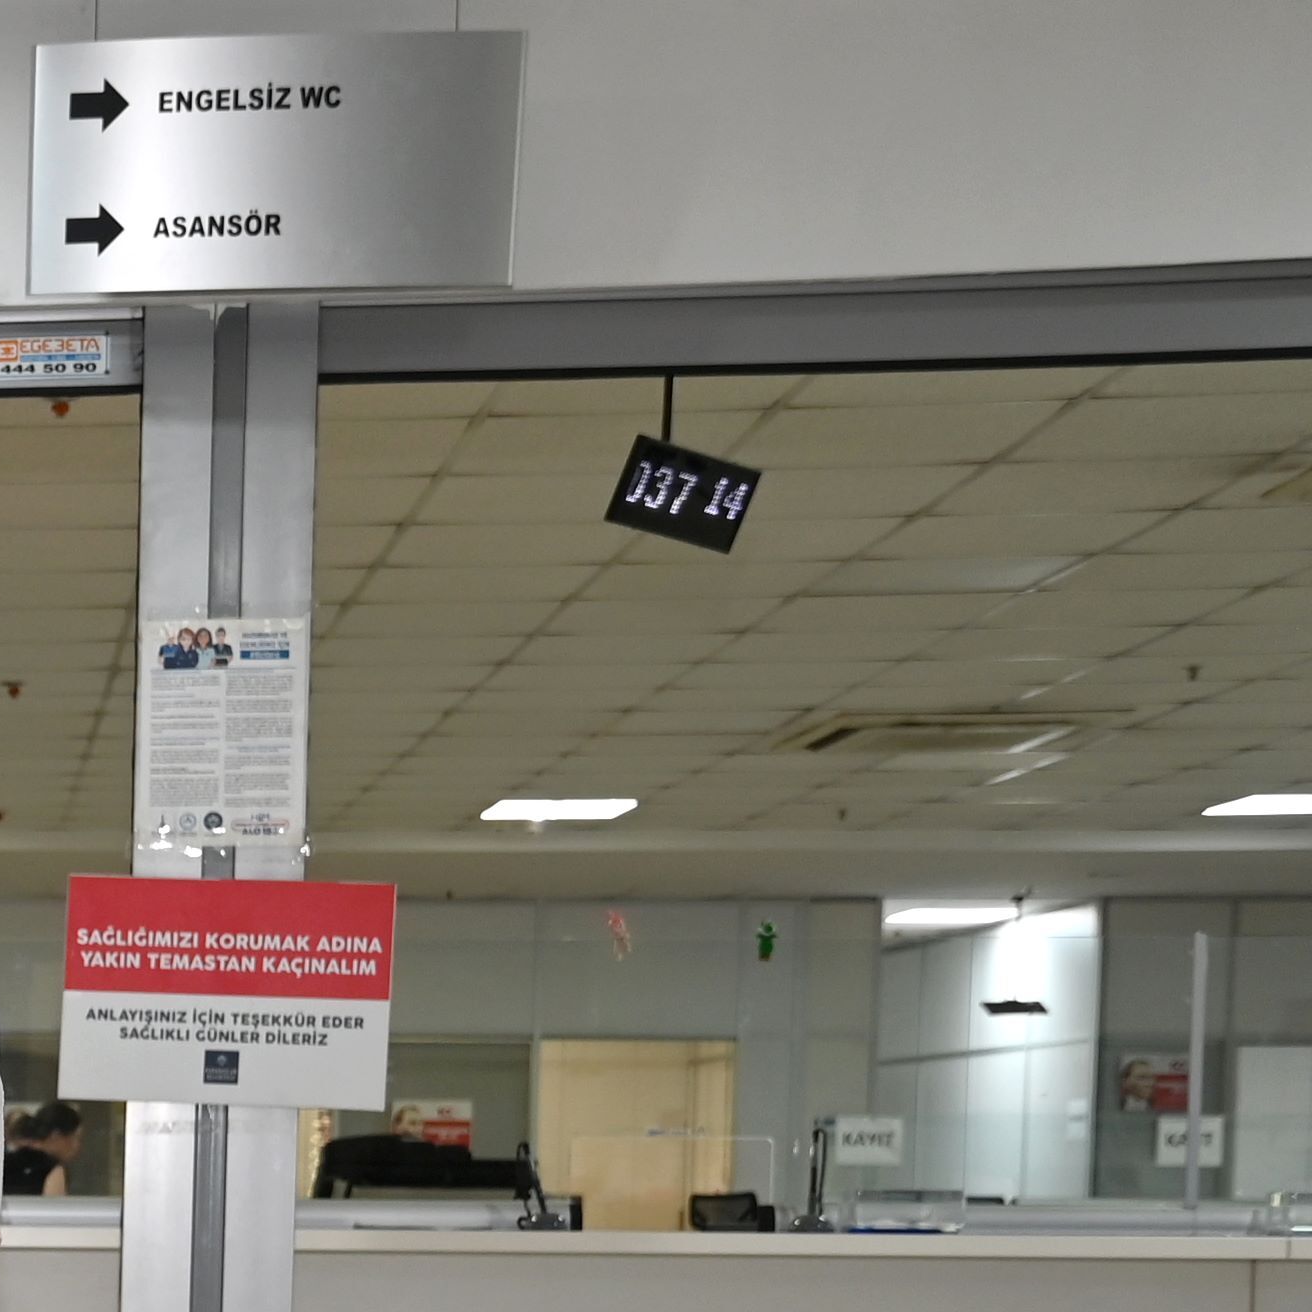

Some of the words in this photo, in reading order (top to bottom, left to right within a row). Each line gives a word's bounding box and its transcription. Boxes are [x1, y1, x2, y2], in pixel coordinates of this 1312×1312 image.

[158, 82, 291, 114] ENGELSİZ
[300, 85, 342, 109] WC
[153, 209, 281, 238] ASANSÖR
[0, 364, 35, 374] 444
[43, 363, 66, 374] 50
[73, 362, 97, 373] 90
[704, 477, 749, 520] 14
[76, 927, 199, 949] SAĞLIĞIMIZI
[205, 931, 310, 952] KORUMAK
[316, 935, 383, 954] ADINA
[80, 950, 141, 970] YAKIN
[147, 953, 256, 973] TEMASTAN
[262, 956, 376, 979] KAÇINALIM
[85, 1008, 187, 1026] ANLAYIŞINIZ
[192, 1008, 225, 1028] İÇİN
[231, 1011, 317, 1030] TEŞEKKÜR
[322, 1015, 365, 1030] EDER
[119, 1024, 190, 1042] SAĞLIKLI
[196, 1027, 261, 1045] GÜNLER
[265, 1029, 329, 1047] DİLERİZ
